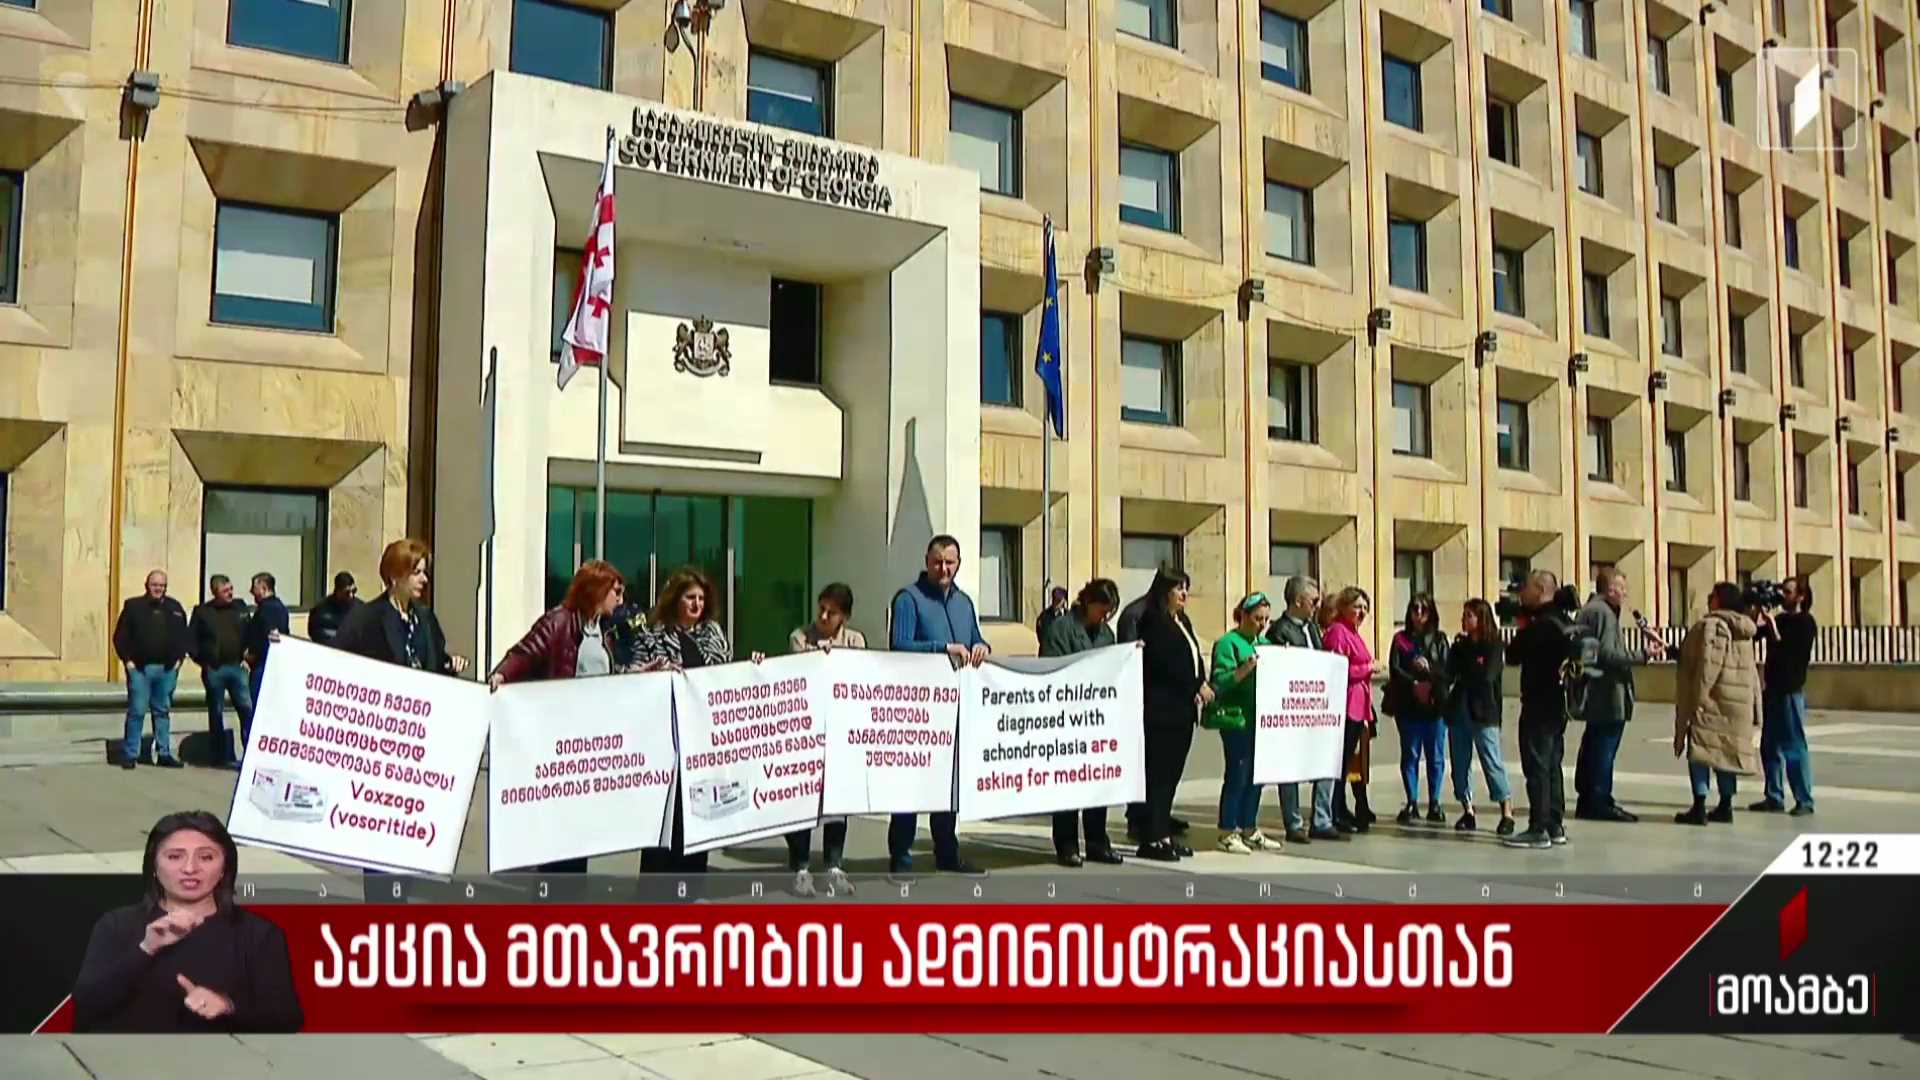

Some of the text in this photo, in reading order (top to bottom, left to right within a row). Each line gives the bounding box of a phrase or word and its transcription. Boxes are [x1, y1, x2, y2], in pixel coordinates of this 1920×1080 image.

[618, 136, 893, 213] GOVERNMENT OF GEORGIA
[305, 673, 432, 717] ვითხოვთ ჩვენი
[708, 677, 808, 707] ვითხოვთ ჩვენი
[833, 682, 849, 700] ნუ
[933, 686, 960, 703] ჩვე
[982, 683, 1118, 706] Parents of children
[305, 697, 427, 739] შვილებისთვის
[712, 698, 809, 726] შვილებისთვის
[870, 706, 930, 724] შვილებს
[997, 708, 1105, 735] diagnosed with
[299, 719, 426, 762] სასიცოცხლოდ
[555, 733, 624, 756] ვითხოვთ
[711, 715, 813, 747] სასიცოცხლოდ
[848, 728, 953, 746] ჯანმრთელობის
[258, 735, 456, 792] მნიშვნელოვან წამალს!
[686, 740, 783, 771] მნიშვნელოვან
[866, 751, 932, 768] უფლებას!
[983, 738, 1118, 762] achondroplasia are
[535, 751, 646, 780] ჯანმრთელობის
[763, 759, 825, 779] Voxzogo
[977, 763, 1122, 793] asking for medicine
[350, 780, 425, 815] Voxzogo
[501, 780, 591, 805] მინისტრთან
[329, 803, 437, 847] (vosoritide)
